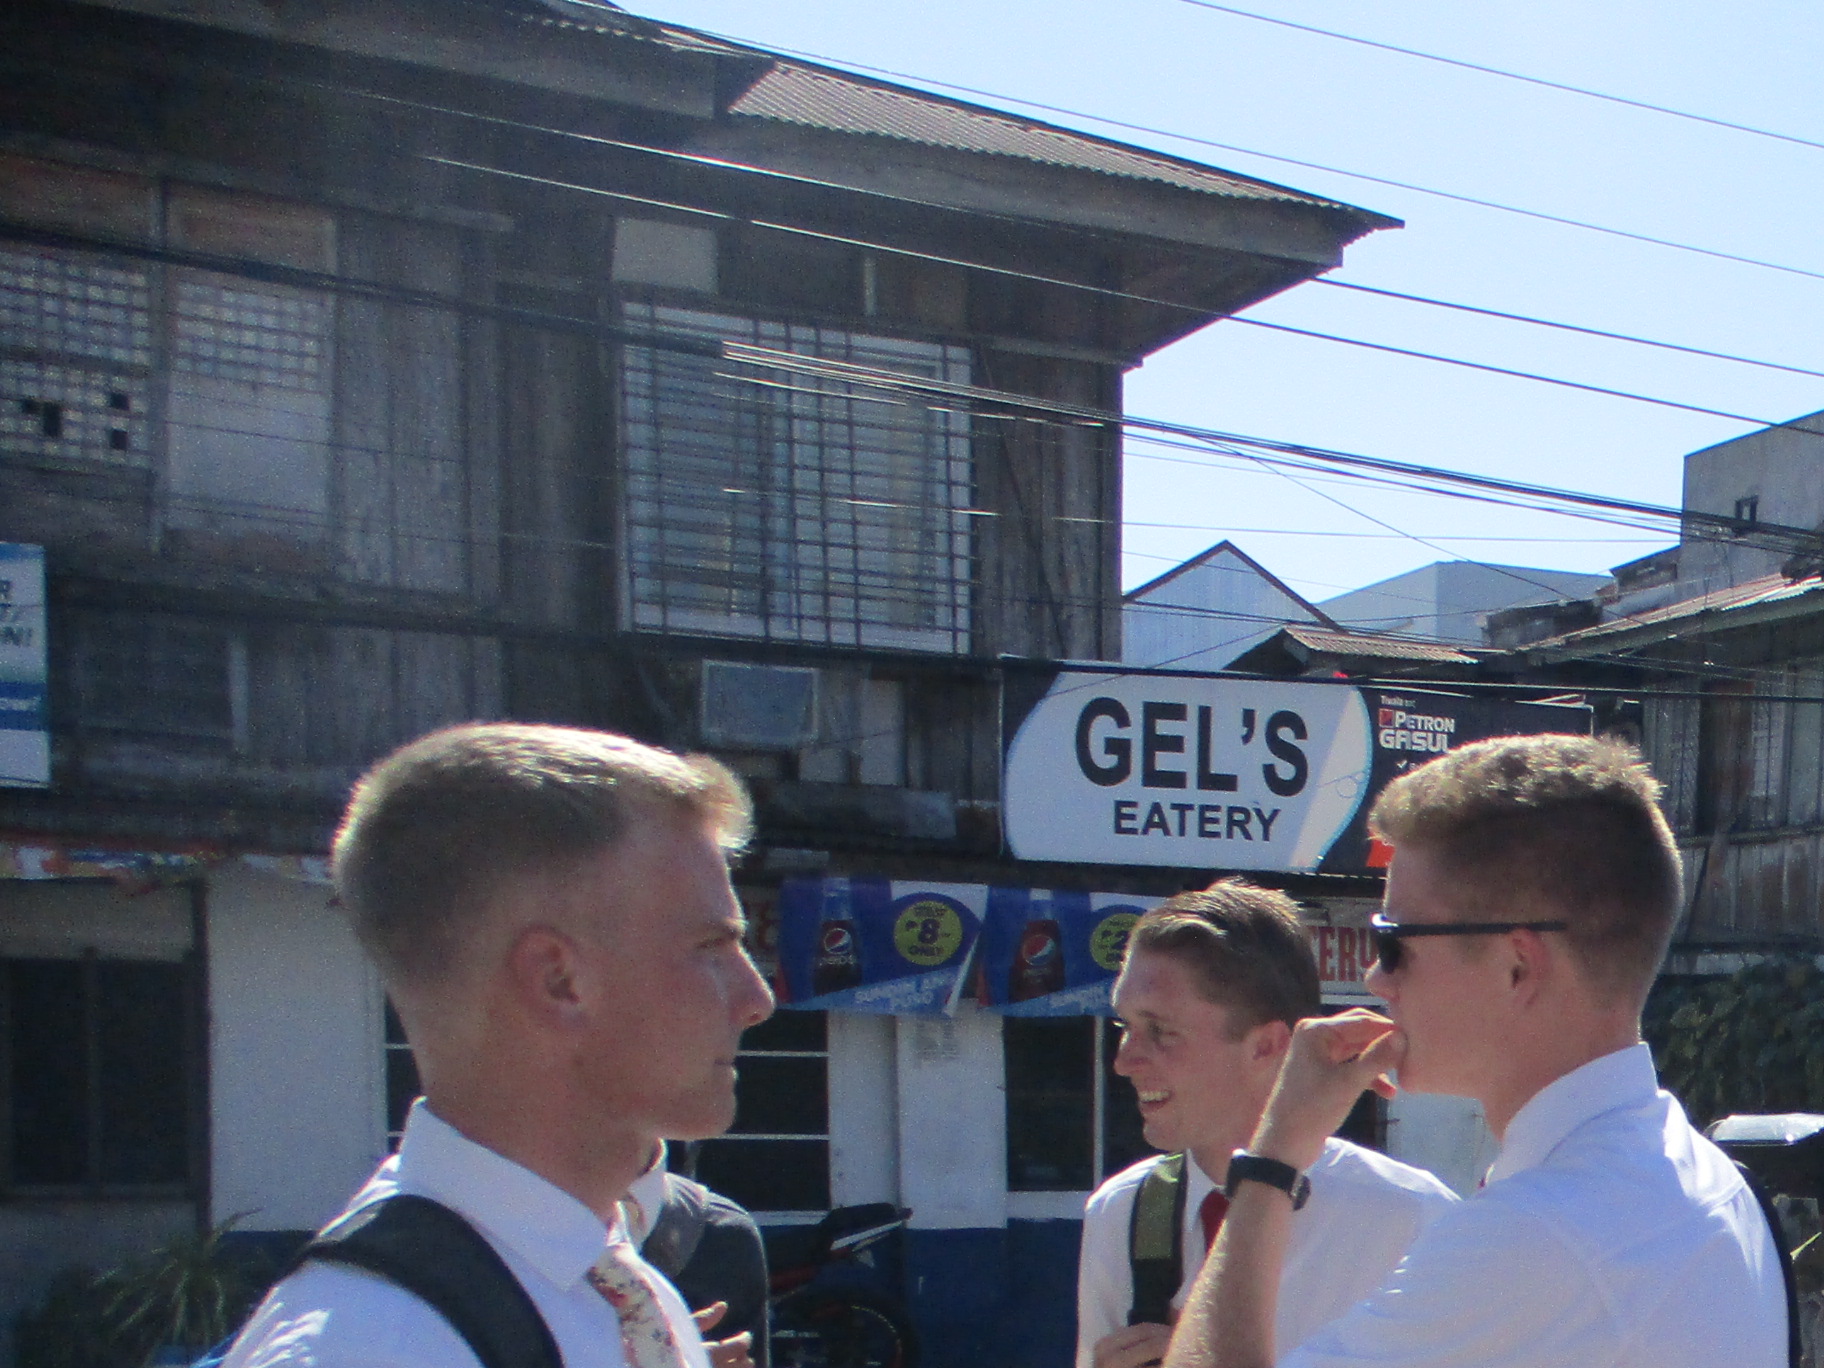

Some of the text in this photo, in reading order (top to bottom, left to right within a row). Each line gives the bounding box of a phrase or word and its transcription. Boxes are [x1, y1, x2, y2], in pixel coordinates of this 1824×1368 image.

[1394, 711, 1456, 734] PETRON
[1075, 696, 1309, 798] GEL'S
[1113, 799, 1282, 843] EATERY
